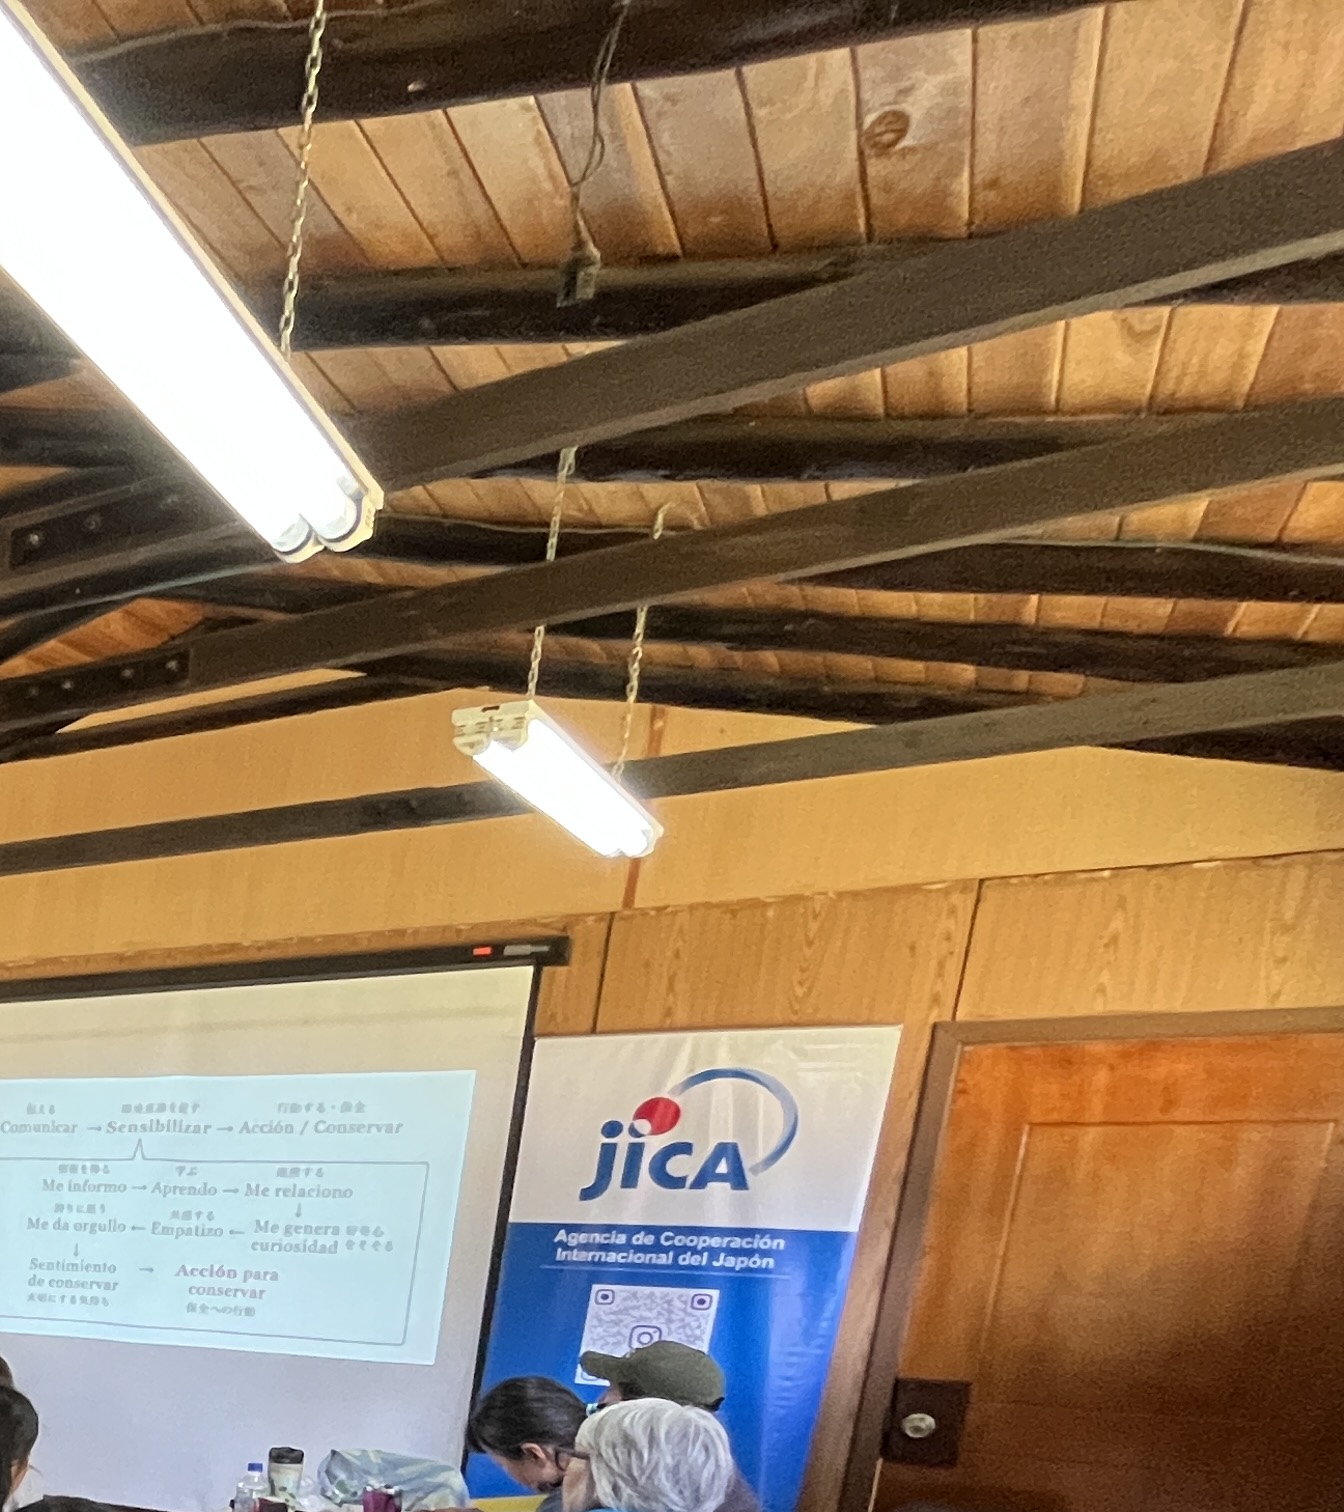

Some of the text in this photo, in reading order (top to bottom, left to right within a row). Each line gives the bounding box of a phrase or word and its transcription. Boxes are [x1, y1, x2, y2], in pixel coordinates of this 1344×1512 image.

[0, 1120, 78, 1134] Comunicar
[106, 1118, 212, 1135] Sensibilizar
[239, 1119, 294, 1134] Acción
[313, 1120, 404, 1135] Conservar
[42, 1178, 353, 1199] Me informo Aprendo Me relaciono
[27, 1216, 340, 1240] Me da orgullo Empatizo Me genera
[250, 1237, 339, 1255] curiosidad
[554, 1229, 785, 1251] Agencia de Cooperación
[29, 1257, 117, 1274] Sentimiento
[555, 1247, 775, 1271] Internacional del Japón
[28, 1274, 119, 1292] de conservar
[174, 1264, 279, 1284] Acción para
[188, 1283, 267, 1300] conservar
